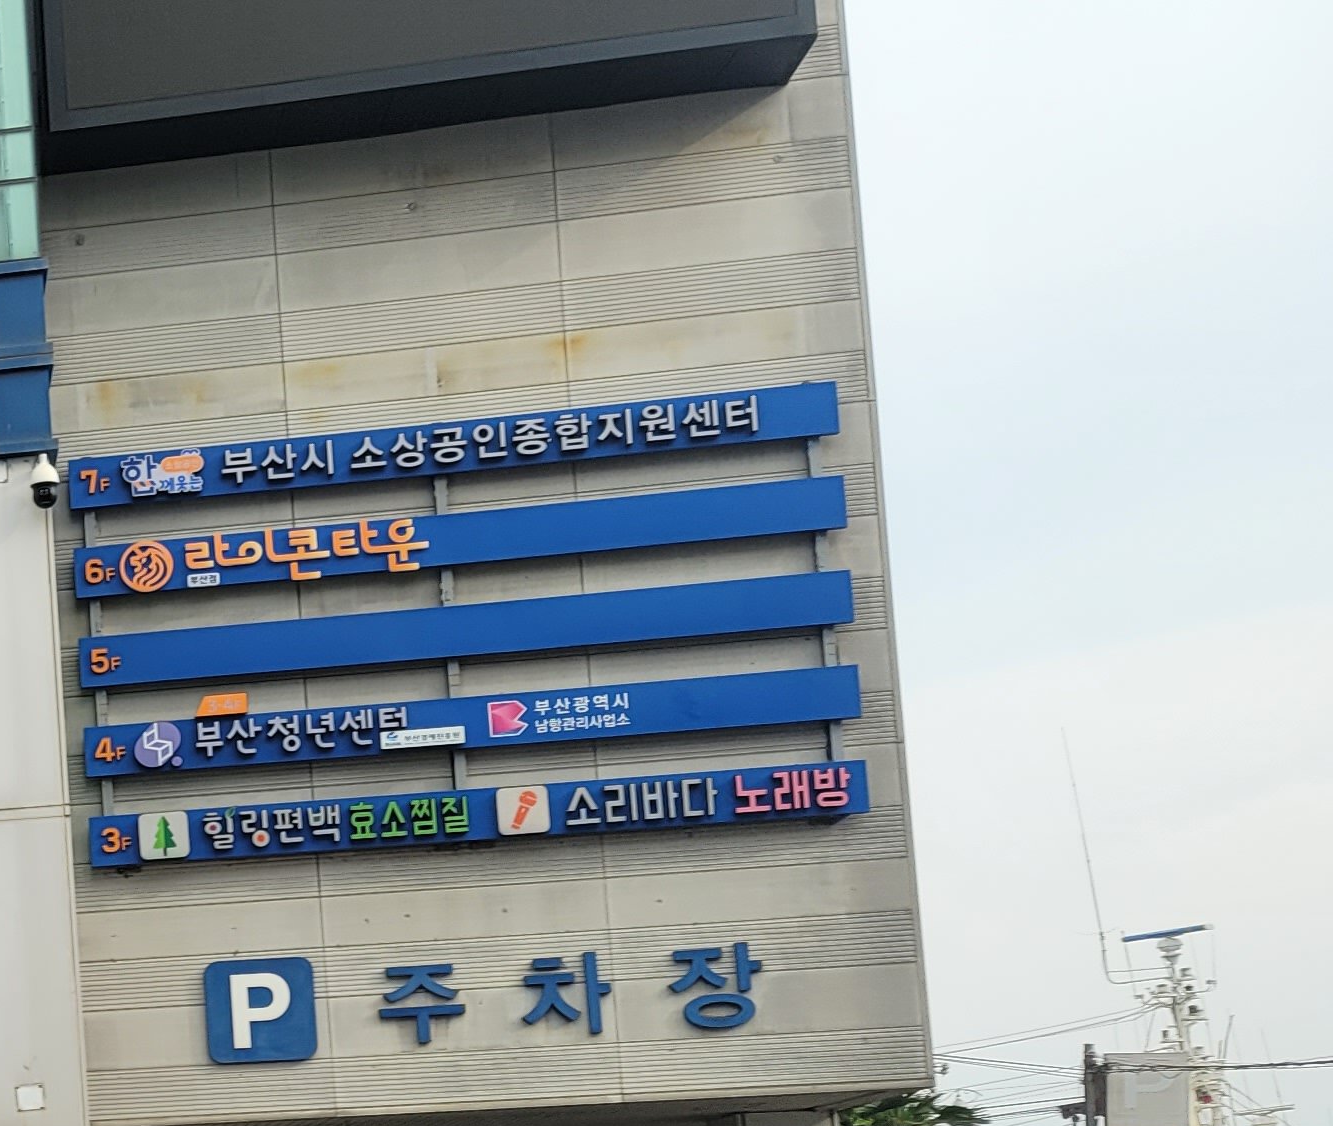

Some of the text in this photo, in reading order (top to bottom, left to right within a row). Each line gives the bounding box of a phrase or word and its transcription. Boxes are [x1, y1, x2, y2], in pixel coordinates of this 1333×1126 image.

[221, 394, 760, 484] 부산시 소상공인종합지원센터
[79, 468, 111, 495] 7F
[183, 518, 430, 581] 라이콘타운
[84, 558, 116, 586] 6F
[89, 647, 122, 674] 5F
[533, 691, 631, 715] 부산광역시
[195, 706, 408, 757] 부산청년센터
[533, 711, 632, 735] 남항관리사업소
[94, 736, 126, 763] 4F
[565, 767, 851, 827] 소리바다 노래방
[100, 827, 133, 854] 3F
[201, 796, 470, 851] 힐링편백 효소찜질
[229, 971, 291, 1051] P
[377, 941, 763, 1046] 주차장
